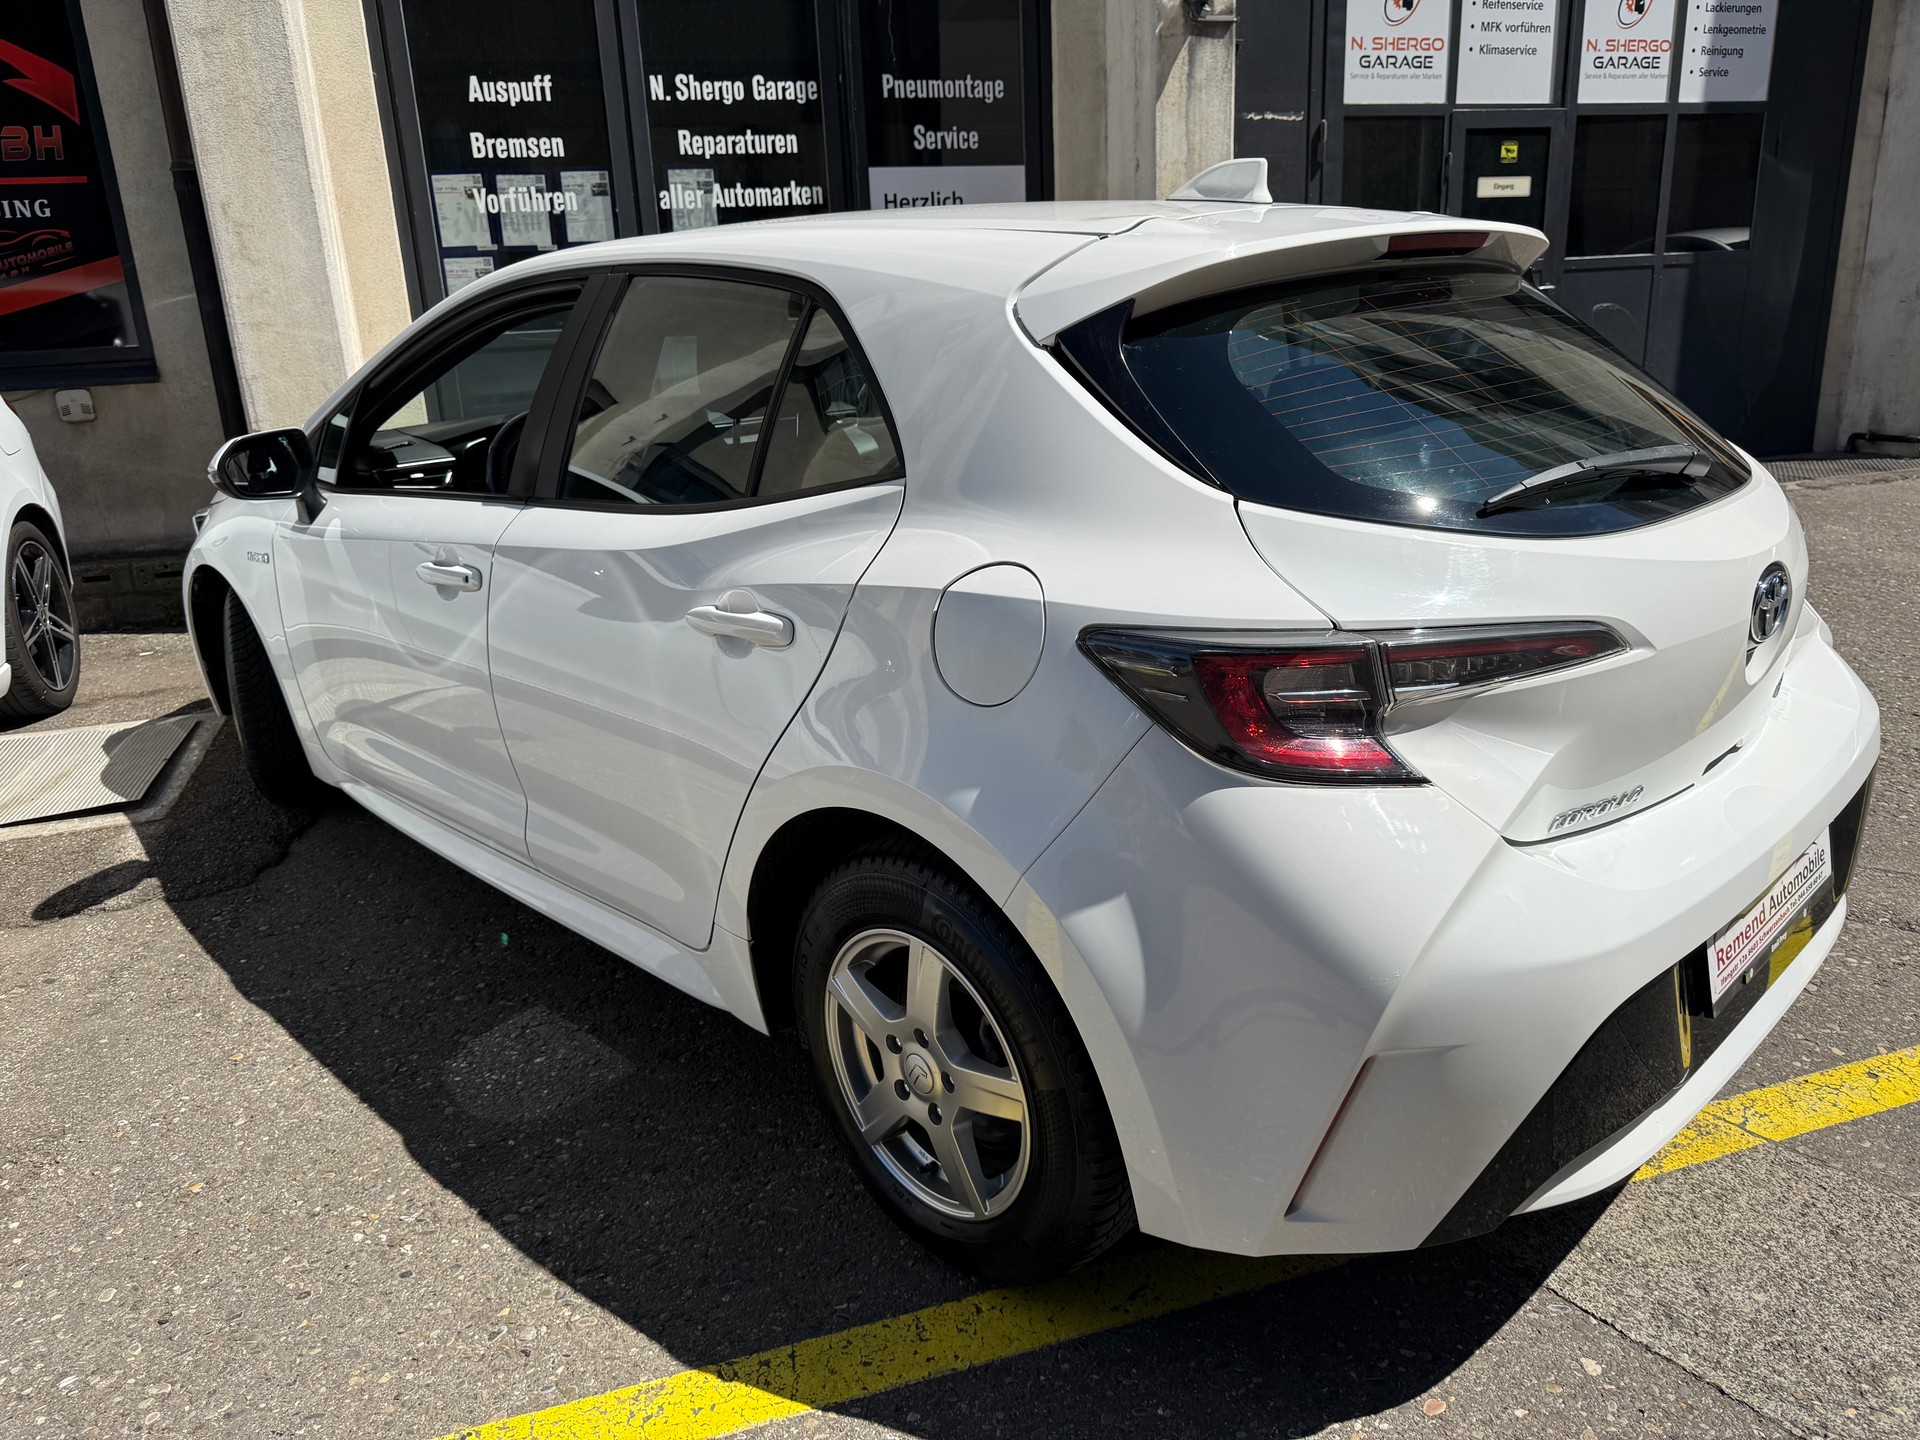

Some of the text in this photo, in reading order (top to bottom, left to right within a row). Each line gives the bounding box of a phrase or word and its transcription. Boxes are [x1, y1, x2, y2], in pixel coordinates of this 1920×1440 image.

[1482, 0, 1544, 11] Reifenservice
[1705, 2, 1762, 15] Lackierungen
[1480, 21, 1551, 33] MFK vorführen
[1703, 24, 1767, 37] Lenkgeometrie
[1351, 36, 1445, 51] N. SHERGO
[1479, 43, 1538, 56] Klimaservice
[1586, 39, 1672, 53] N. SHERGO
[1700, 45, 1744, 59] Reinigung
[1359, 55, 1434, 69] GARAGE
[1593, 56, 1661, 69] GARAGE
[1698, 66, 1729, 77] Service
[468, 75, 552, 106] Auspuff
[649, 73, 818, 105] N. Shergo Garage
[881, 74, 1005, 103] Pneumontage
[469, 132, 565, 159] Bremsen
[677, 129, 798, 159] Reparaturen
[913, 124, 979, 151] Service
[659, 180, 824, 210] aller Automarken
[1493, 183, 1515, 191] Eingang
[0, 199, 51, 218] ING
[472, 186, 578, 214] Vorführen
[884, 191, 964, 210] Herzlich
[1547, 785, 1645, 833] COROLLA
[1716, 848, 1826, 972] Remend Automobile
[931, 914, 1038, 1044] Continental
